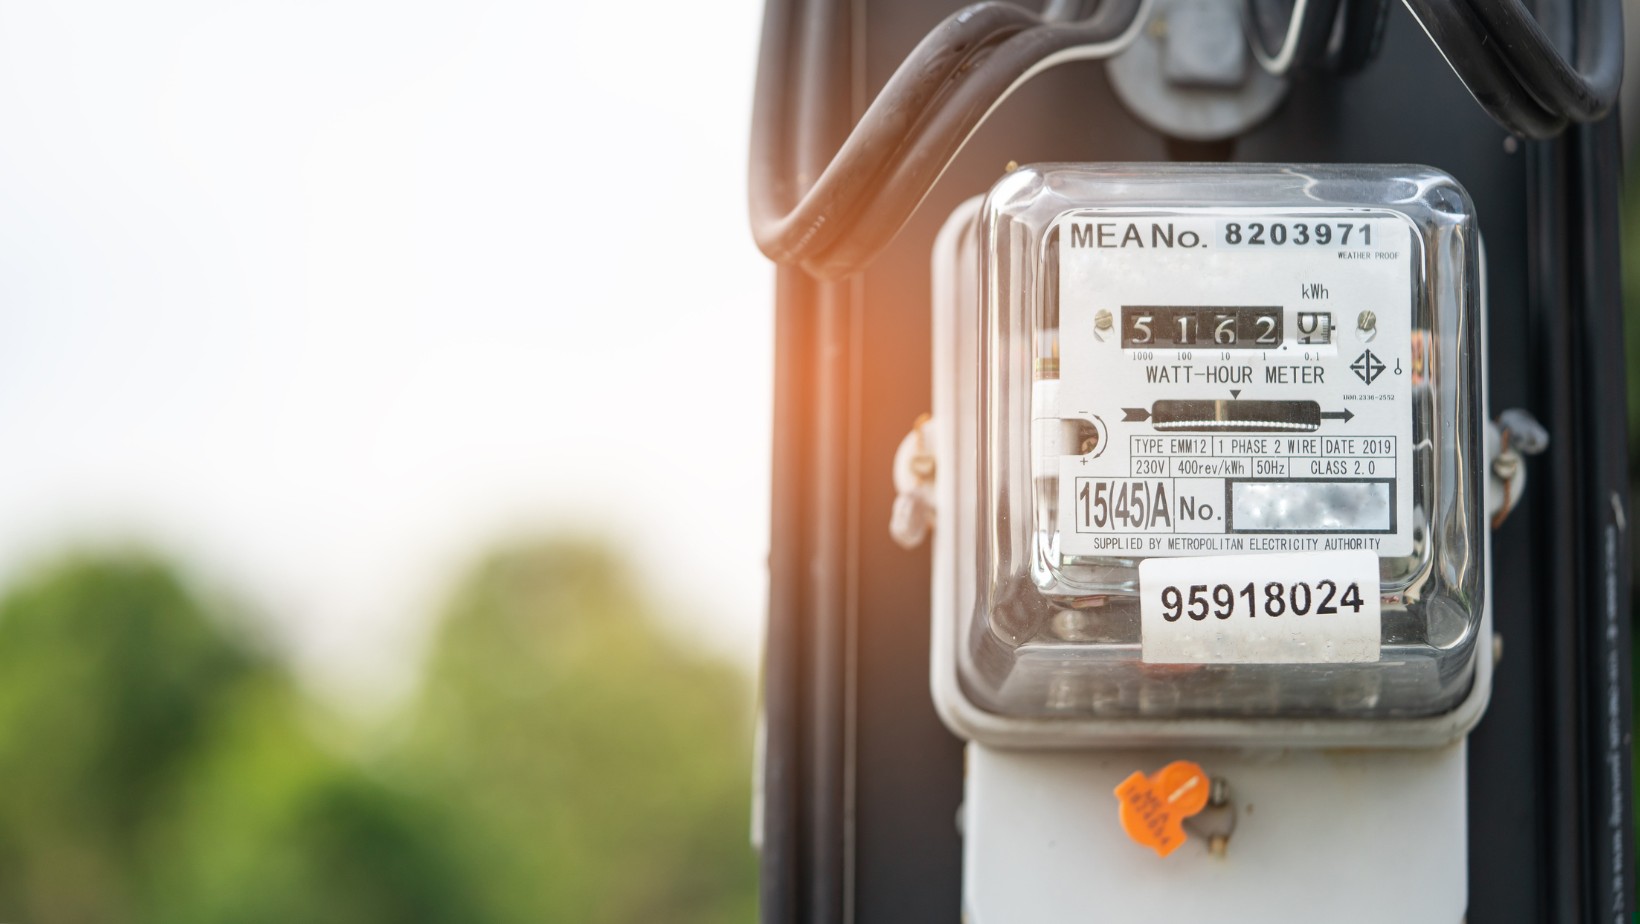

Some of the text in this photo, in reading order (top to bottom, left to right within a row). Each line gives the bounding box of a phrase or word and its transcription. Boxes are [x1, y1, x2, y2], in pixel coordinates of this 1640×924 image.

[1225, 223, 1370, 245] 8203971
[1337, 251, 1400, 260] WEATHER PROOF
[1302, 284, 1328, 299] kWh
[1132, 352, 1154, 361] 1000
[1177, 352, 1193, 361] 100
[1221, 352, 1231, 361] 10
[1304, 352, 1320, 362] 0.1
[1146, 366, 1324, 383] WATT-HOUR METER
[1135, 439, 1206, 453] TYPE EMM12
[1232, 439, 1267, 453] PHASE
[1275, 440, 1280, 453] 2
[1288, 440, 1316, 453] WIRE
[1326, 440, 1390, 454] DATE 2019
[1136, 460, 1164, 474] 230V
[1178, 460, 1244, 475] 400rev/kWh
[1257, 460, 1284, 474] 50Hz
[1311, 460, 1375, 474] CLASS 2.0
[1080, 481, 1171, 530] 15(45)A
[1180, 496, 1221, 520] No.
[1094, 538, 1380, 550] SUPPLIED BY METROPOLITAN ELECTRICITY AUTHORITY
[1162, 579, 1364, 622] 95918024
